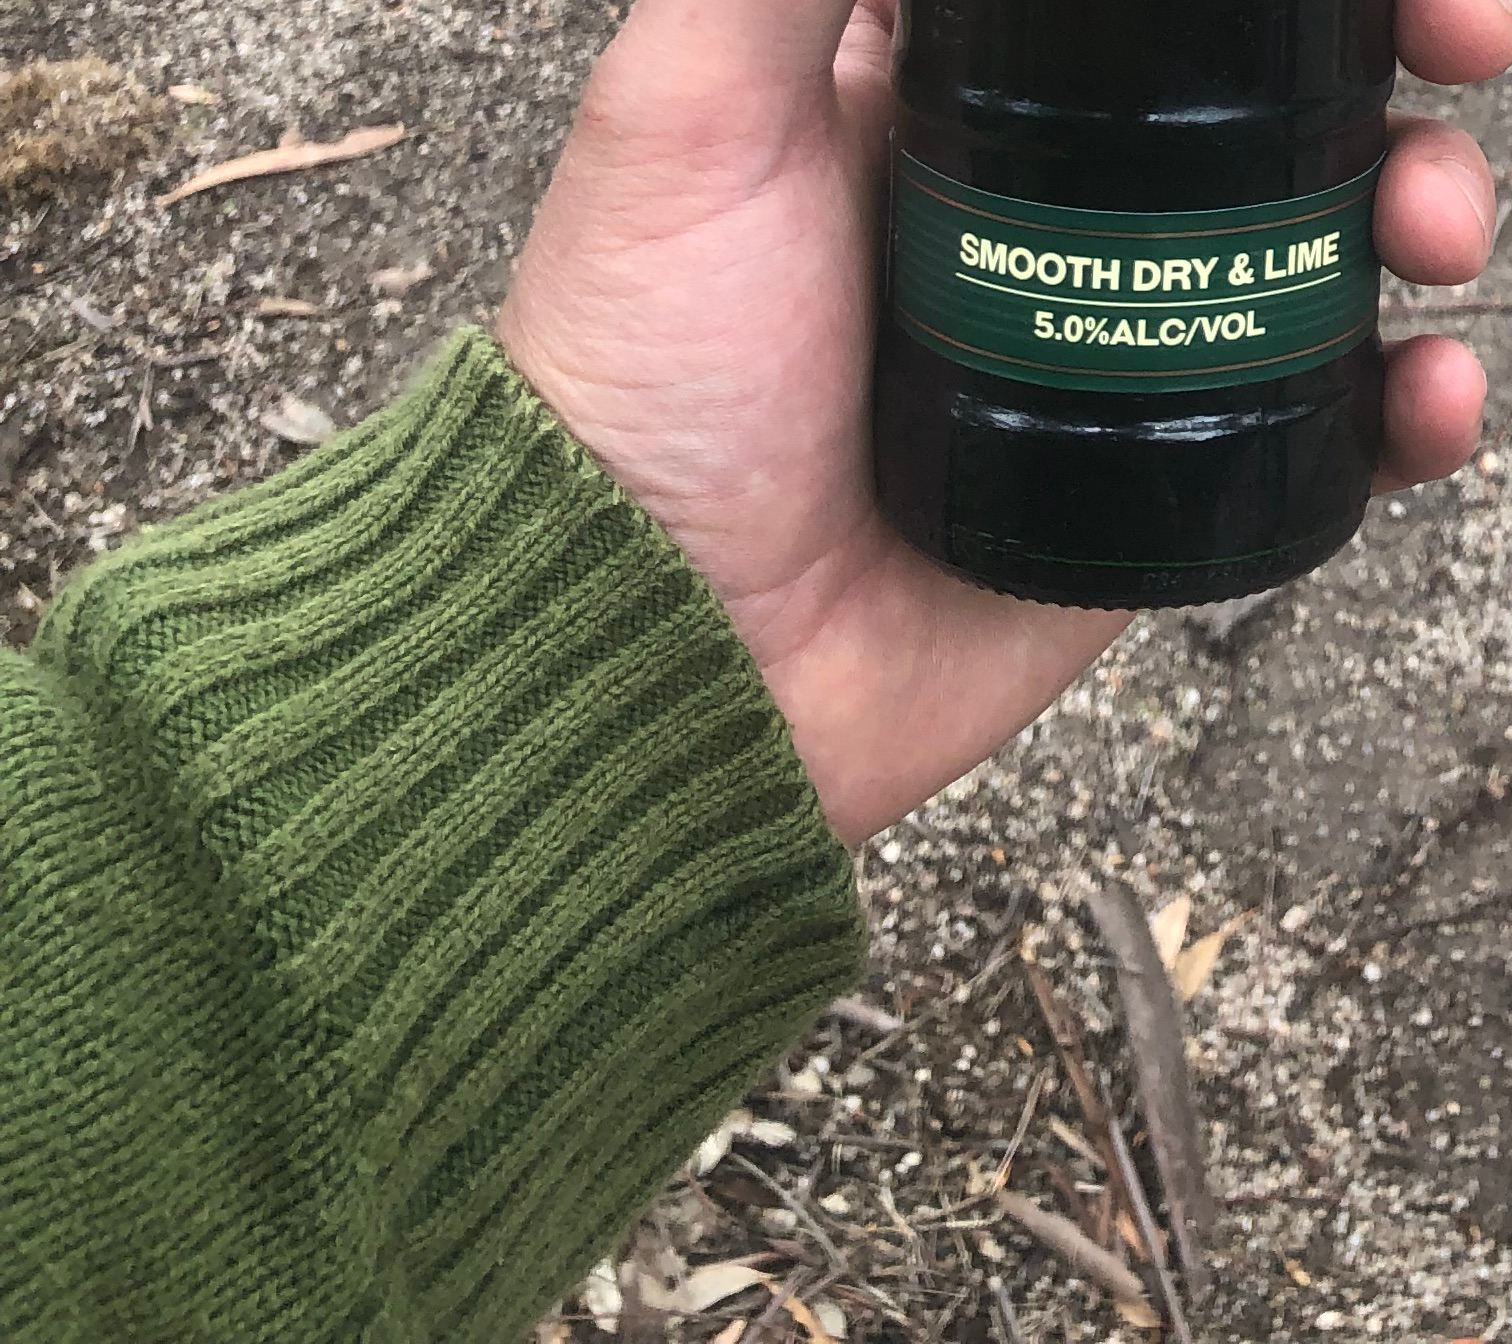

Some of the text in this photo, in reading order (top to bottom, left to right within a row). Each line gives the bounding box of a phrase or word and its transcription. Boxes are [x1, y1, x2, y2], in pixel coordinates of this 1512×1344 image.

[959, 231, 1340, 292] SMOOTH DRY & LIME
[1033, 310, 1266, 346] 5.0%ALC/VOL
